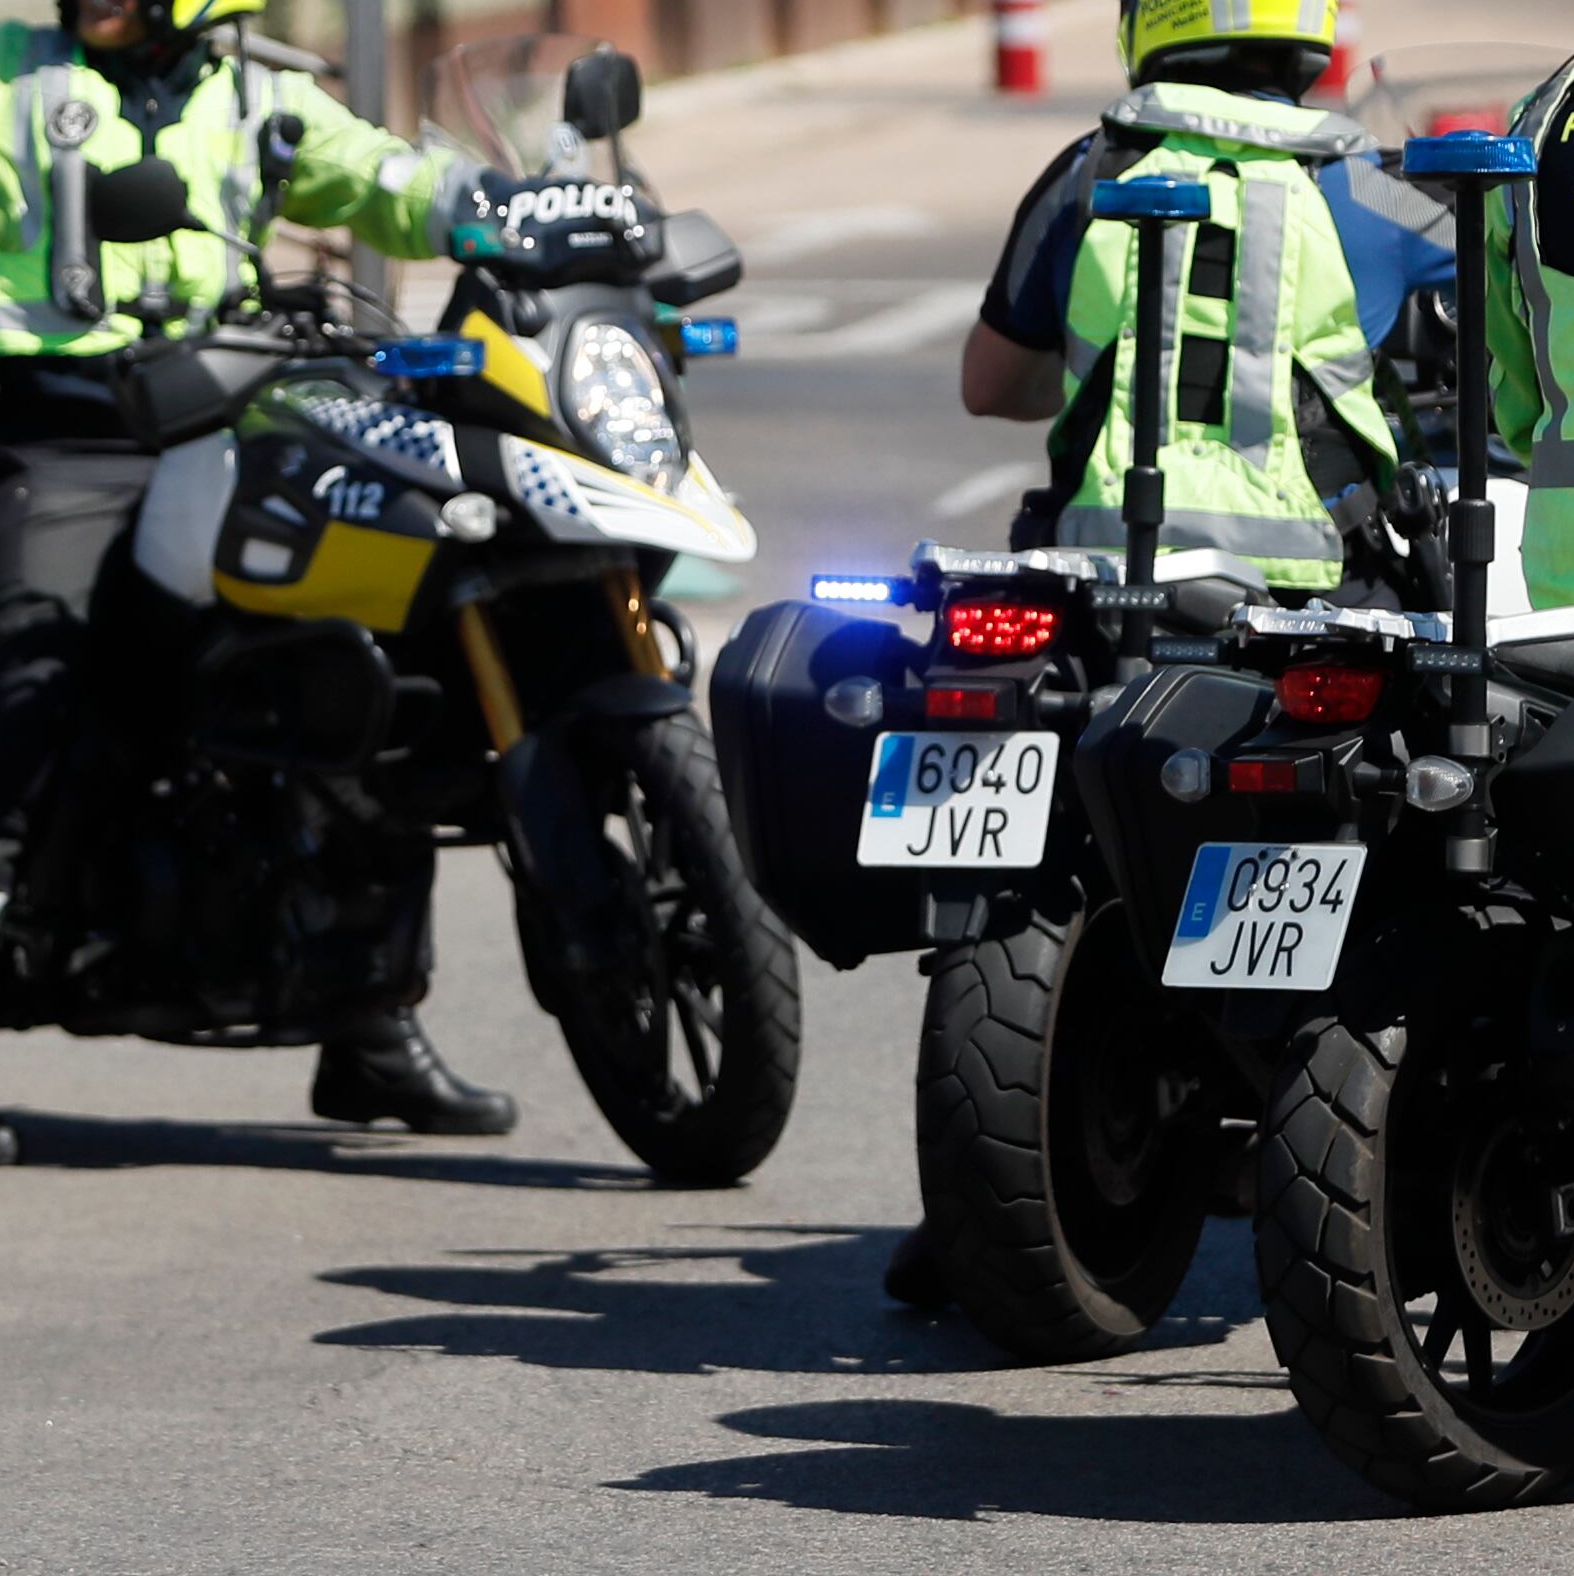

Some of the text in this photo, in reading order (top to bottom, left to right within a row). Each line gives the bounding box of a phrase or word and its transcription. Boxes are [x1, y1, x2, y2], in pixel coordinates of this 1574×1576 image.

[329, 479, 385, 520] 112
[916, 742, 1044, 794] 6040
[907, 806, 1009, 857] JVR
[1227, 856, 1348, 914] 0934
[1190, 902, 1206, 921] E
[1210, 920, 1304, 977] JVR
